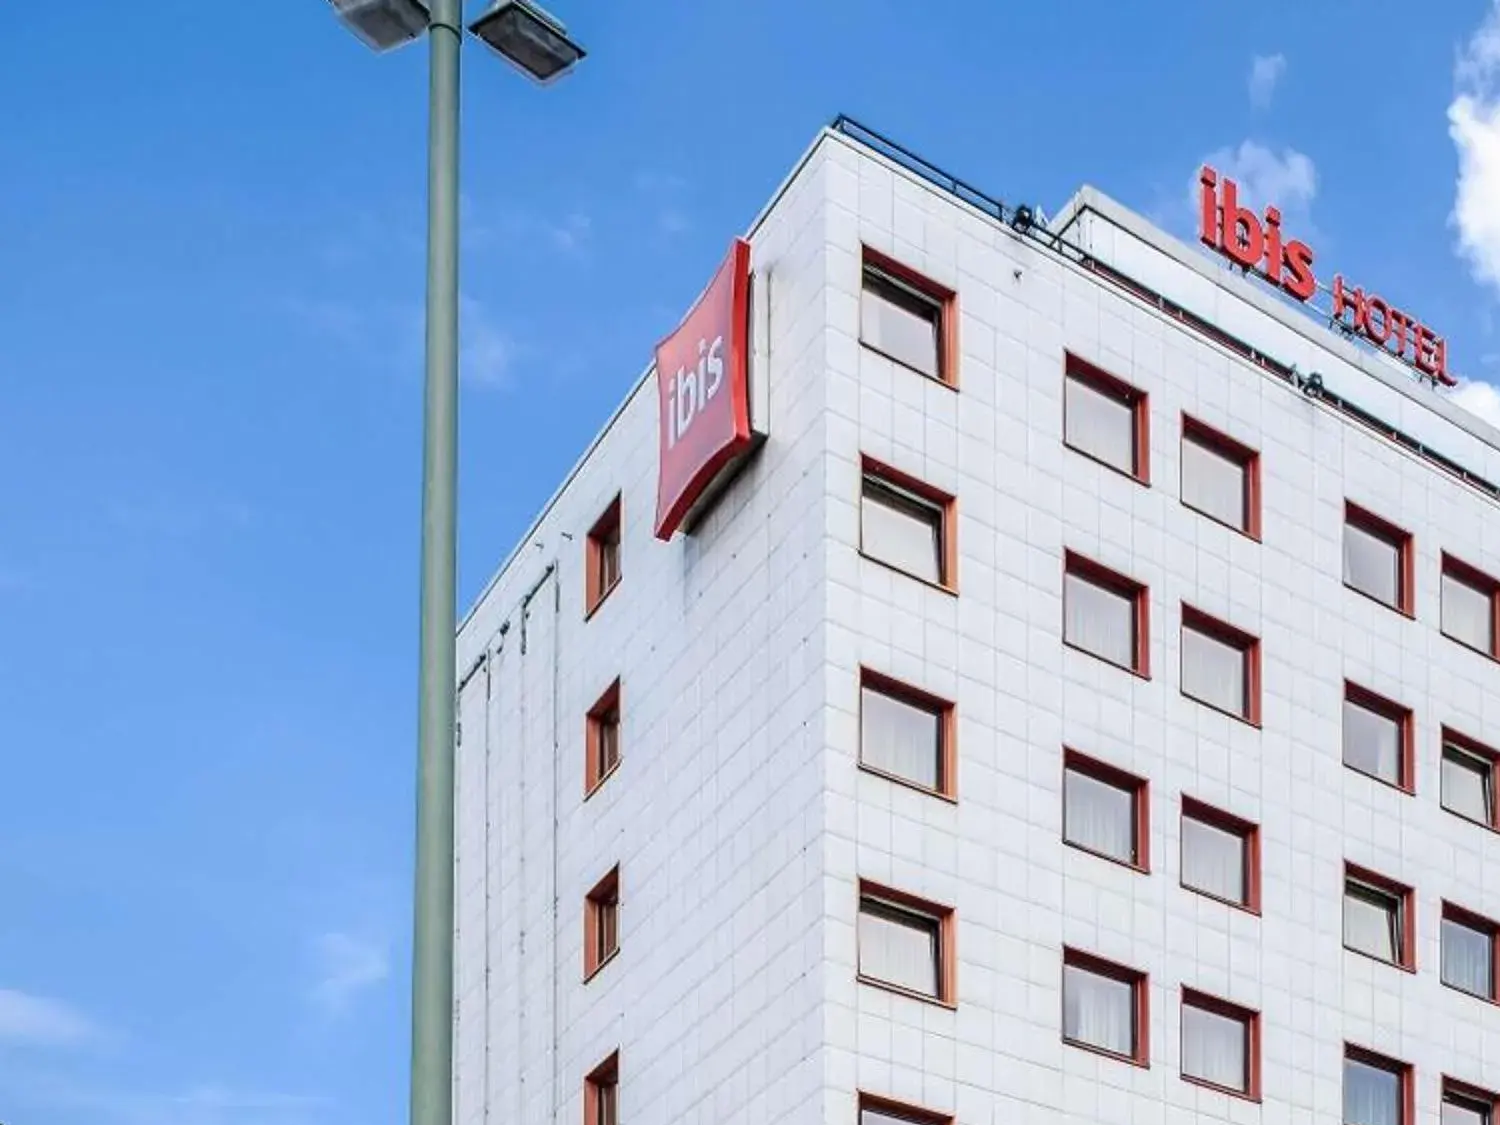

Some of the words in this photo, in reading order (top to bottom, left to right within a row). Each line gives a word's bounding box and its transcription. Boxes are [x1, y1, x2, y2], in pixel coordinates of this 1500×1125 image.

[1200, 165, 1316, 303] ibis
[1332, 274, 1457, 387] HOTEL
[668, 335, 723, 448] ibis
